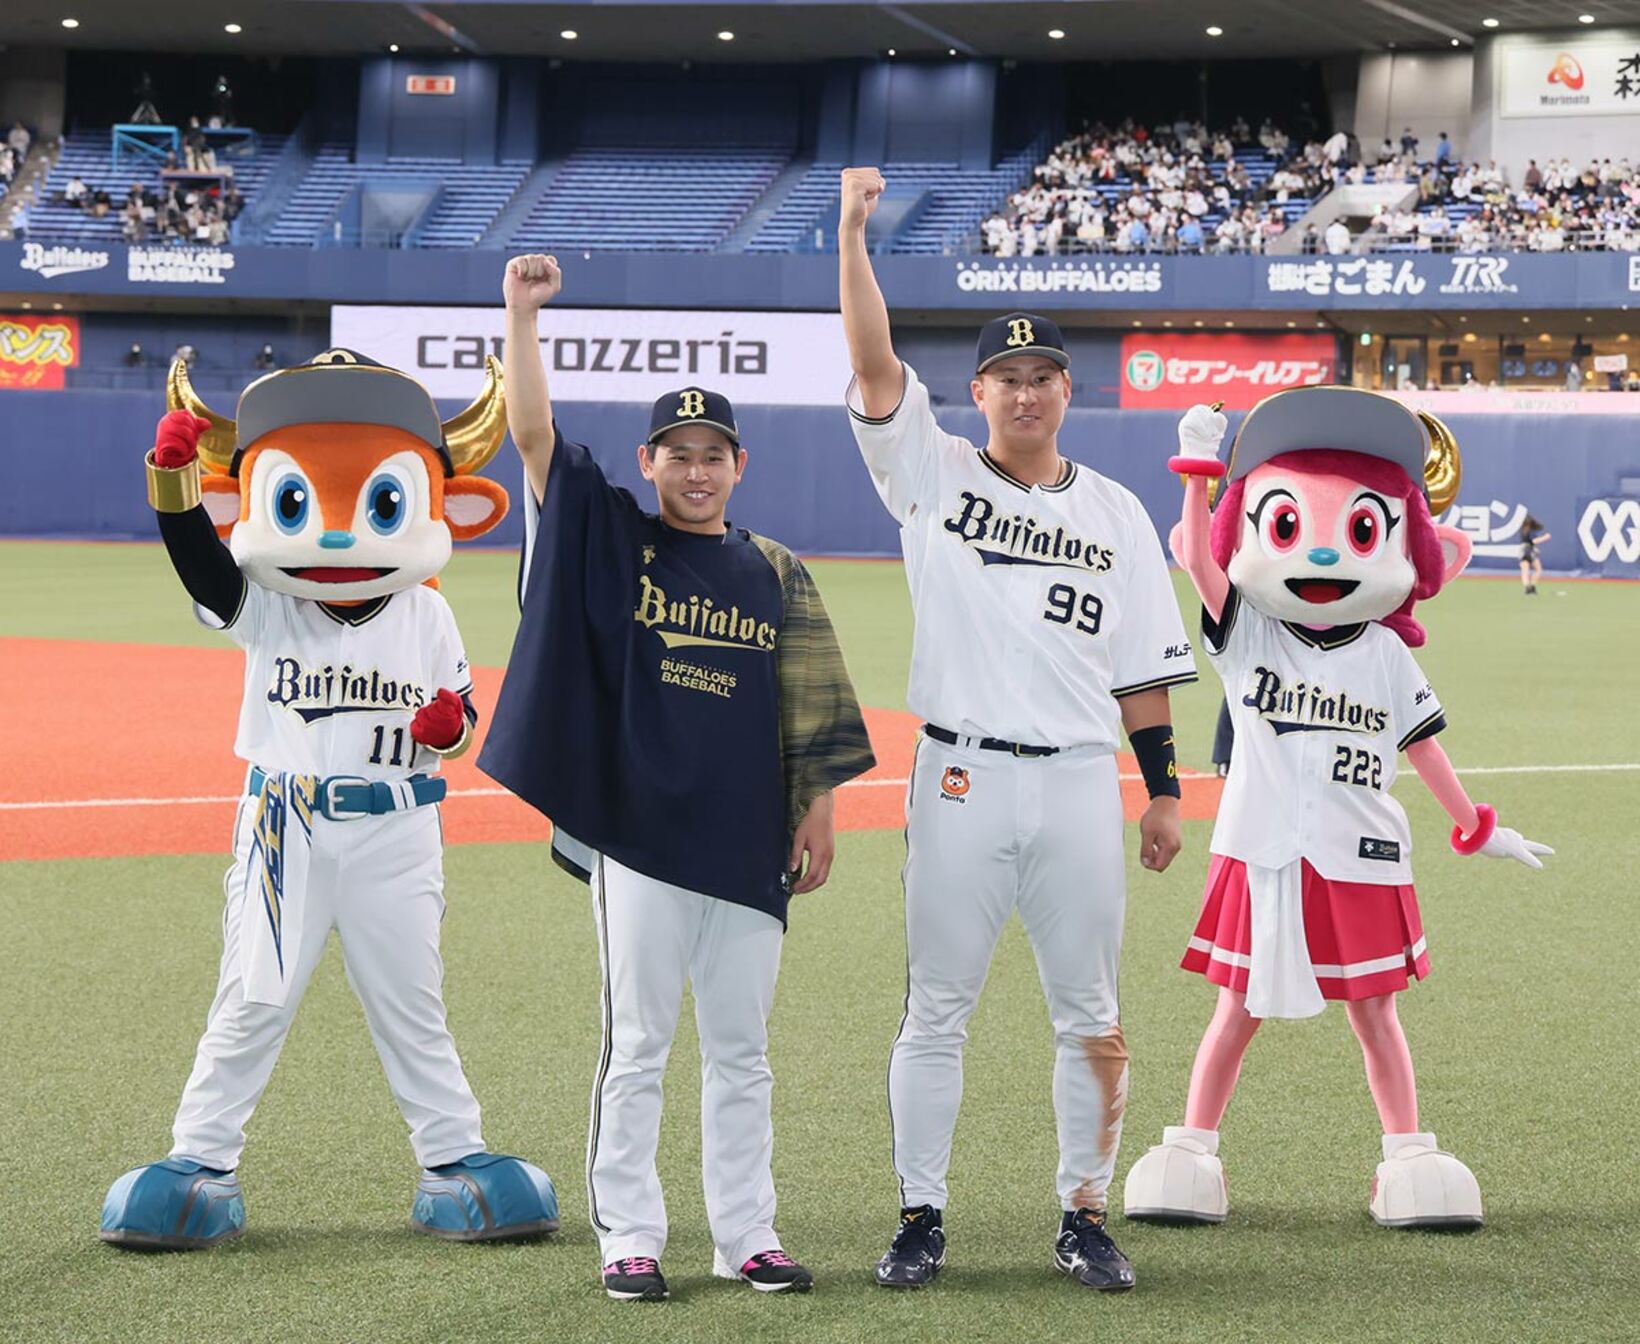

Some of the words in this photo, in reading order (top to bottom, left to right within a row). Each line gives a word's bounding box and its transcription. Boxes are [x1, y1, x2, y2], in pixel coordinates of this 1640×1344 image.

[128, 266, 226, 283] BASEBALL
[956, 269, 1018, 292] ORIX
[1019, 269, 1162, 292] BUFFALOES
[1006, 318, 1035, 347] B
[676, 390, 705, 418] B
[943, 490, 1114, 573] Buffaloes
[633, 574, 777, 651] Buffaloes
[1043, 582, 1104, 636] 99
[267, 656, 426, 709] Buffaloes
[660, 659, 738, 688] BUFFALOES
[661, 671, 732, 698] BASEBALL
[1242, 666, 1389, 733] Buffaloes
[1331, 745, 1383, 791] 222
